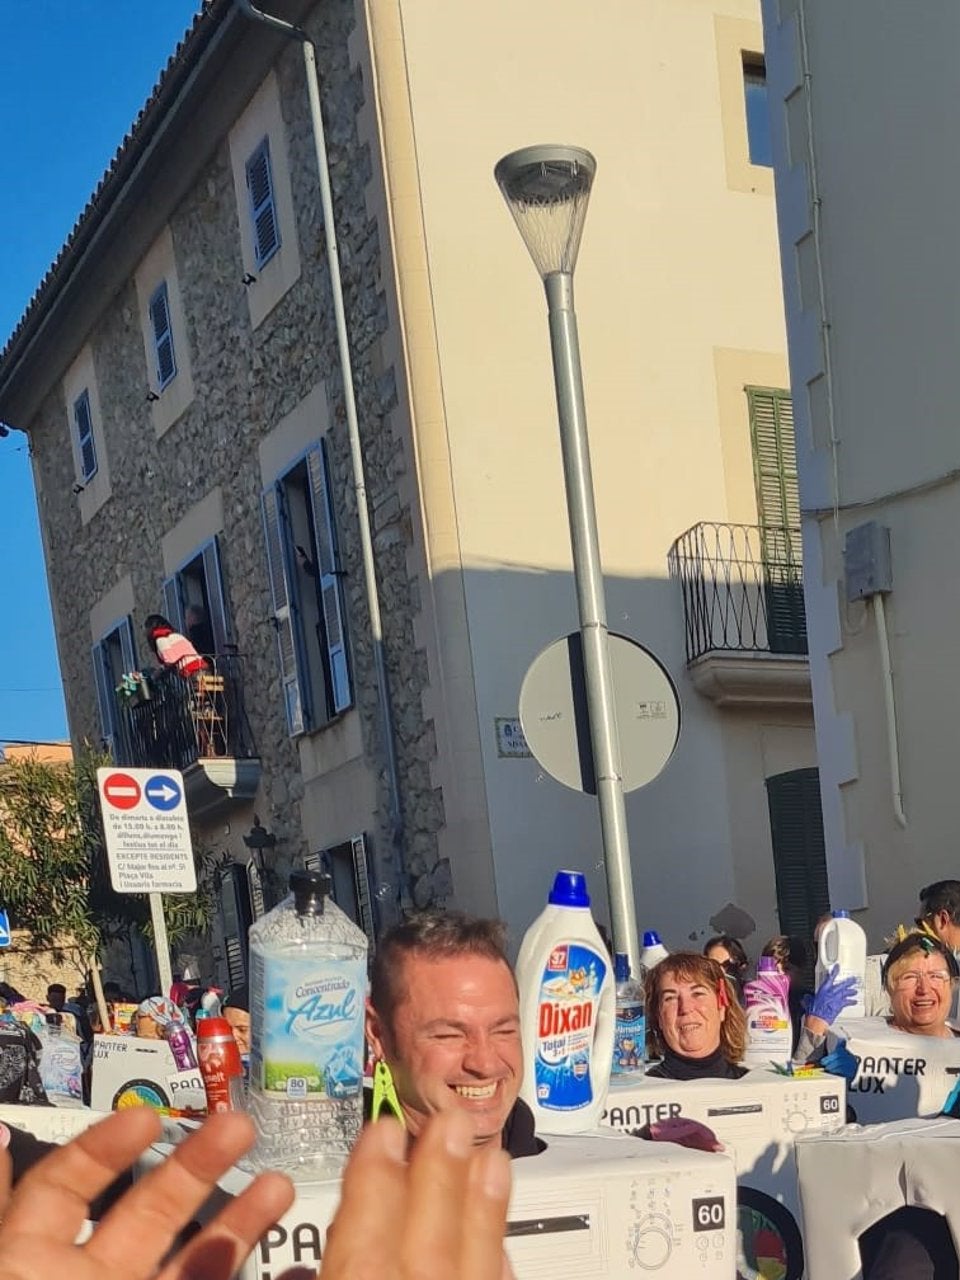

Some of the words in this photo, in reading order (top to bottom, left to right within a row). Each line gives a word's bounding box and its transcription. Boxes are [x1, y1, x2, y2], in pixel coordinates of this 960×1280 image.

[116, 852, 149, 861] EXCEPTE
[149, 853, 190, 861] RESIDENTS
[295, 978, 350, 998] Concentrado
[285, 988, 356, 1035] Azul
[539, 1001, 593, 1039] Dixan
[94, 1041, 128, 1053] PANTER
[543, 1037, 566, 1052] Total
[290, 1078, 305, 1088] 80
[823, 1097, 838, 1111] 60
[698, 1203, 722, 1225] 60
[260, 1222, 333, 1264] PA
